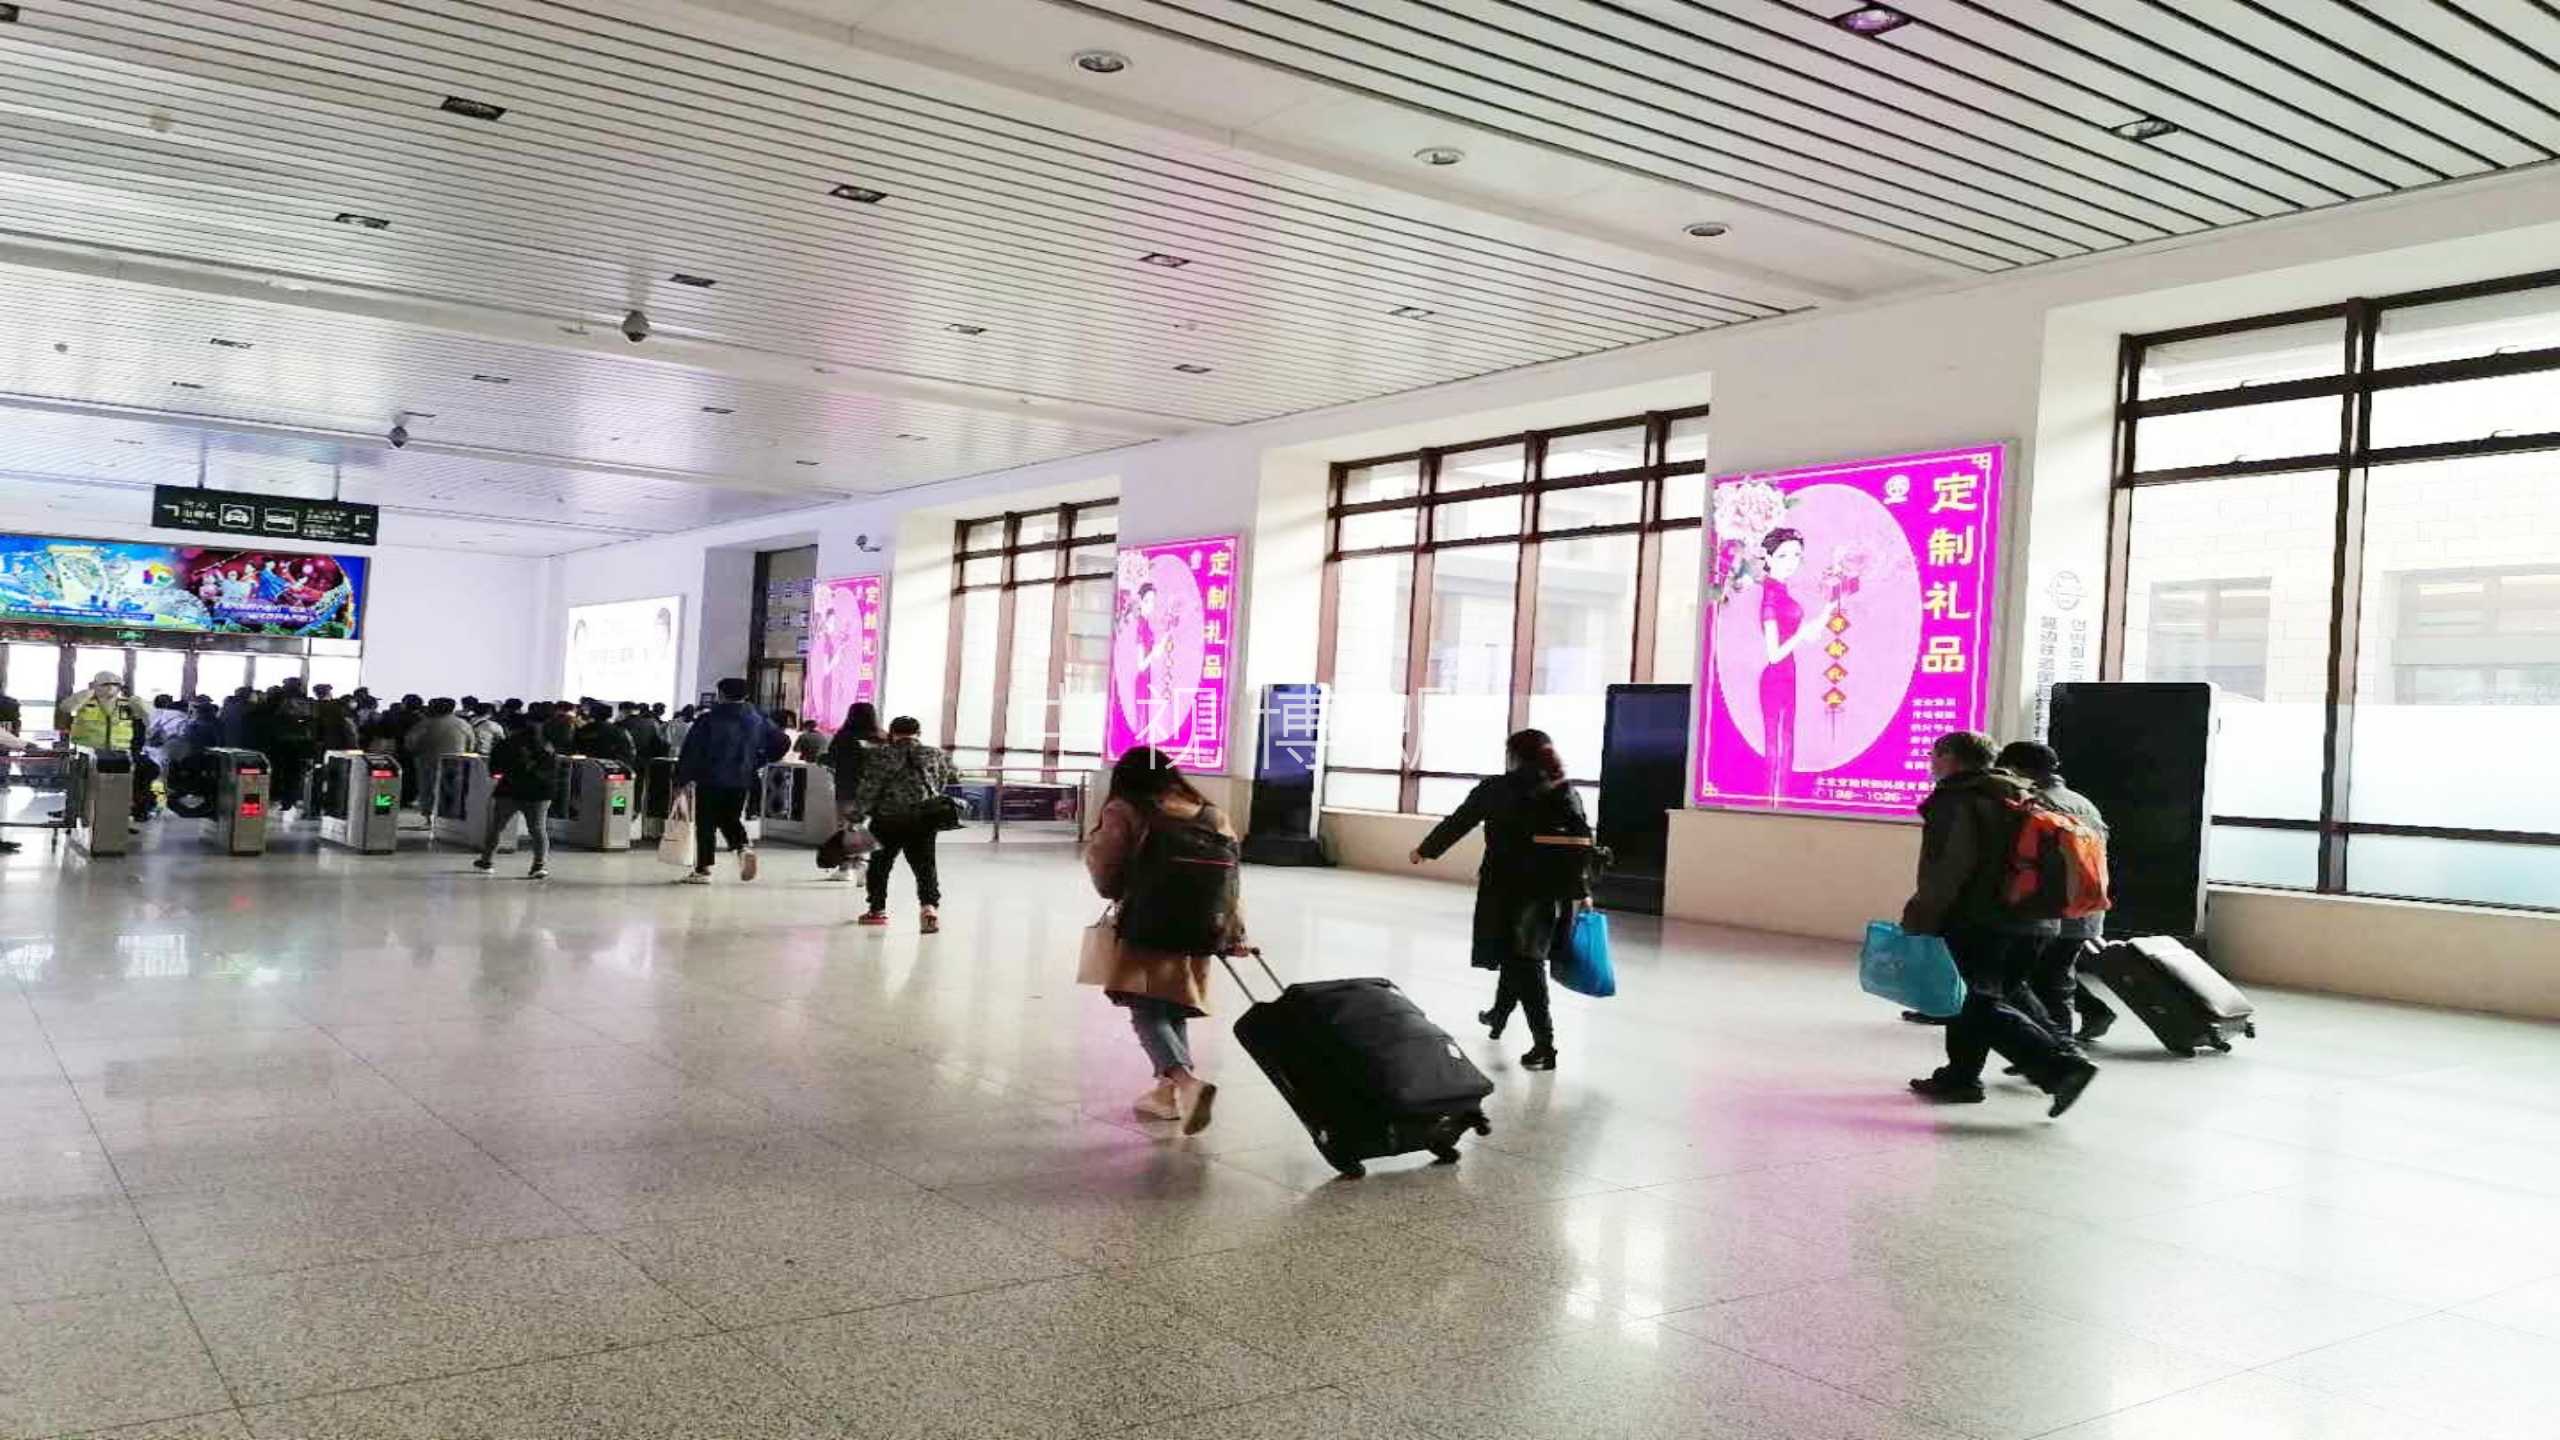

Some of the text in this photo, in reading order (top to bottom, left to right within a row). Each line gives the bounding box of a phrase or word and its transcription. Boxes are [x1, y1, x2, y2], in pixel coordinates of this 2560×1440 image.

[1203, 551, 1230, 680] 定制礼品
[1922, 473, 1978, 673] 定制礼品
